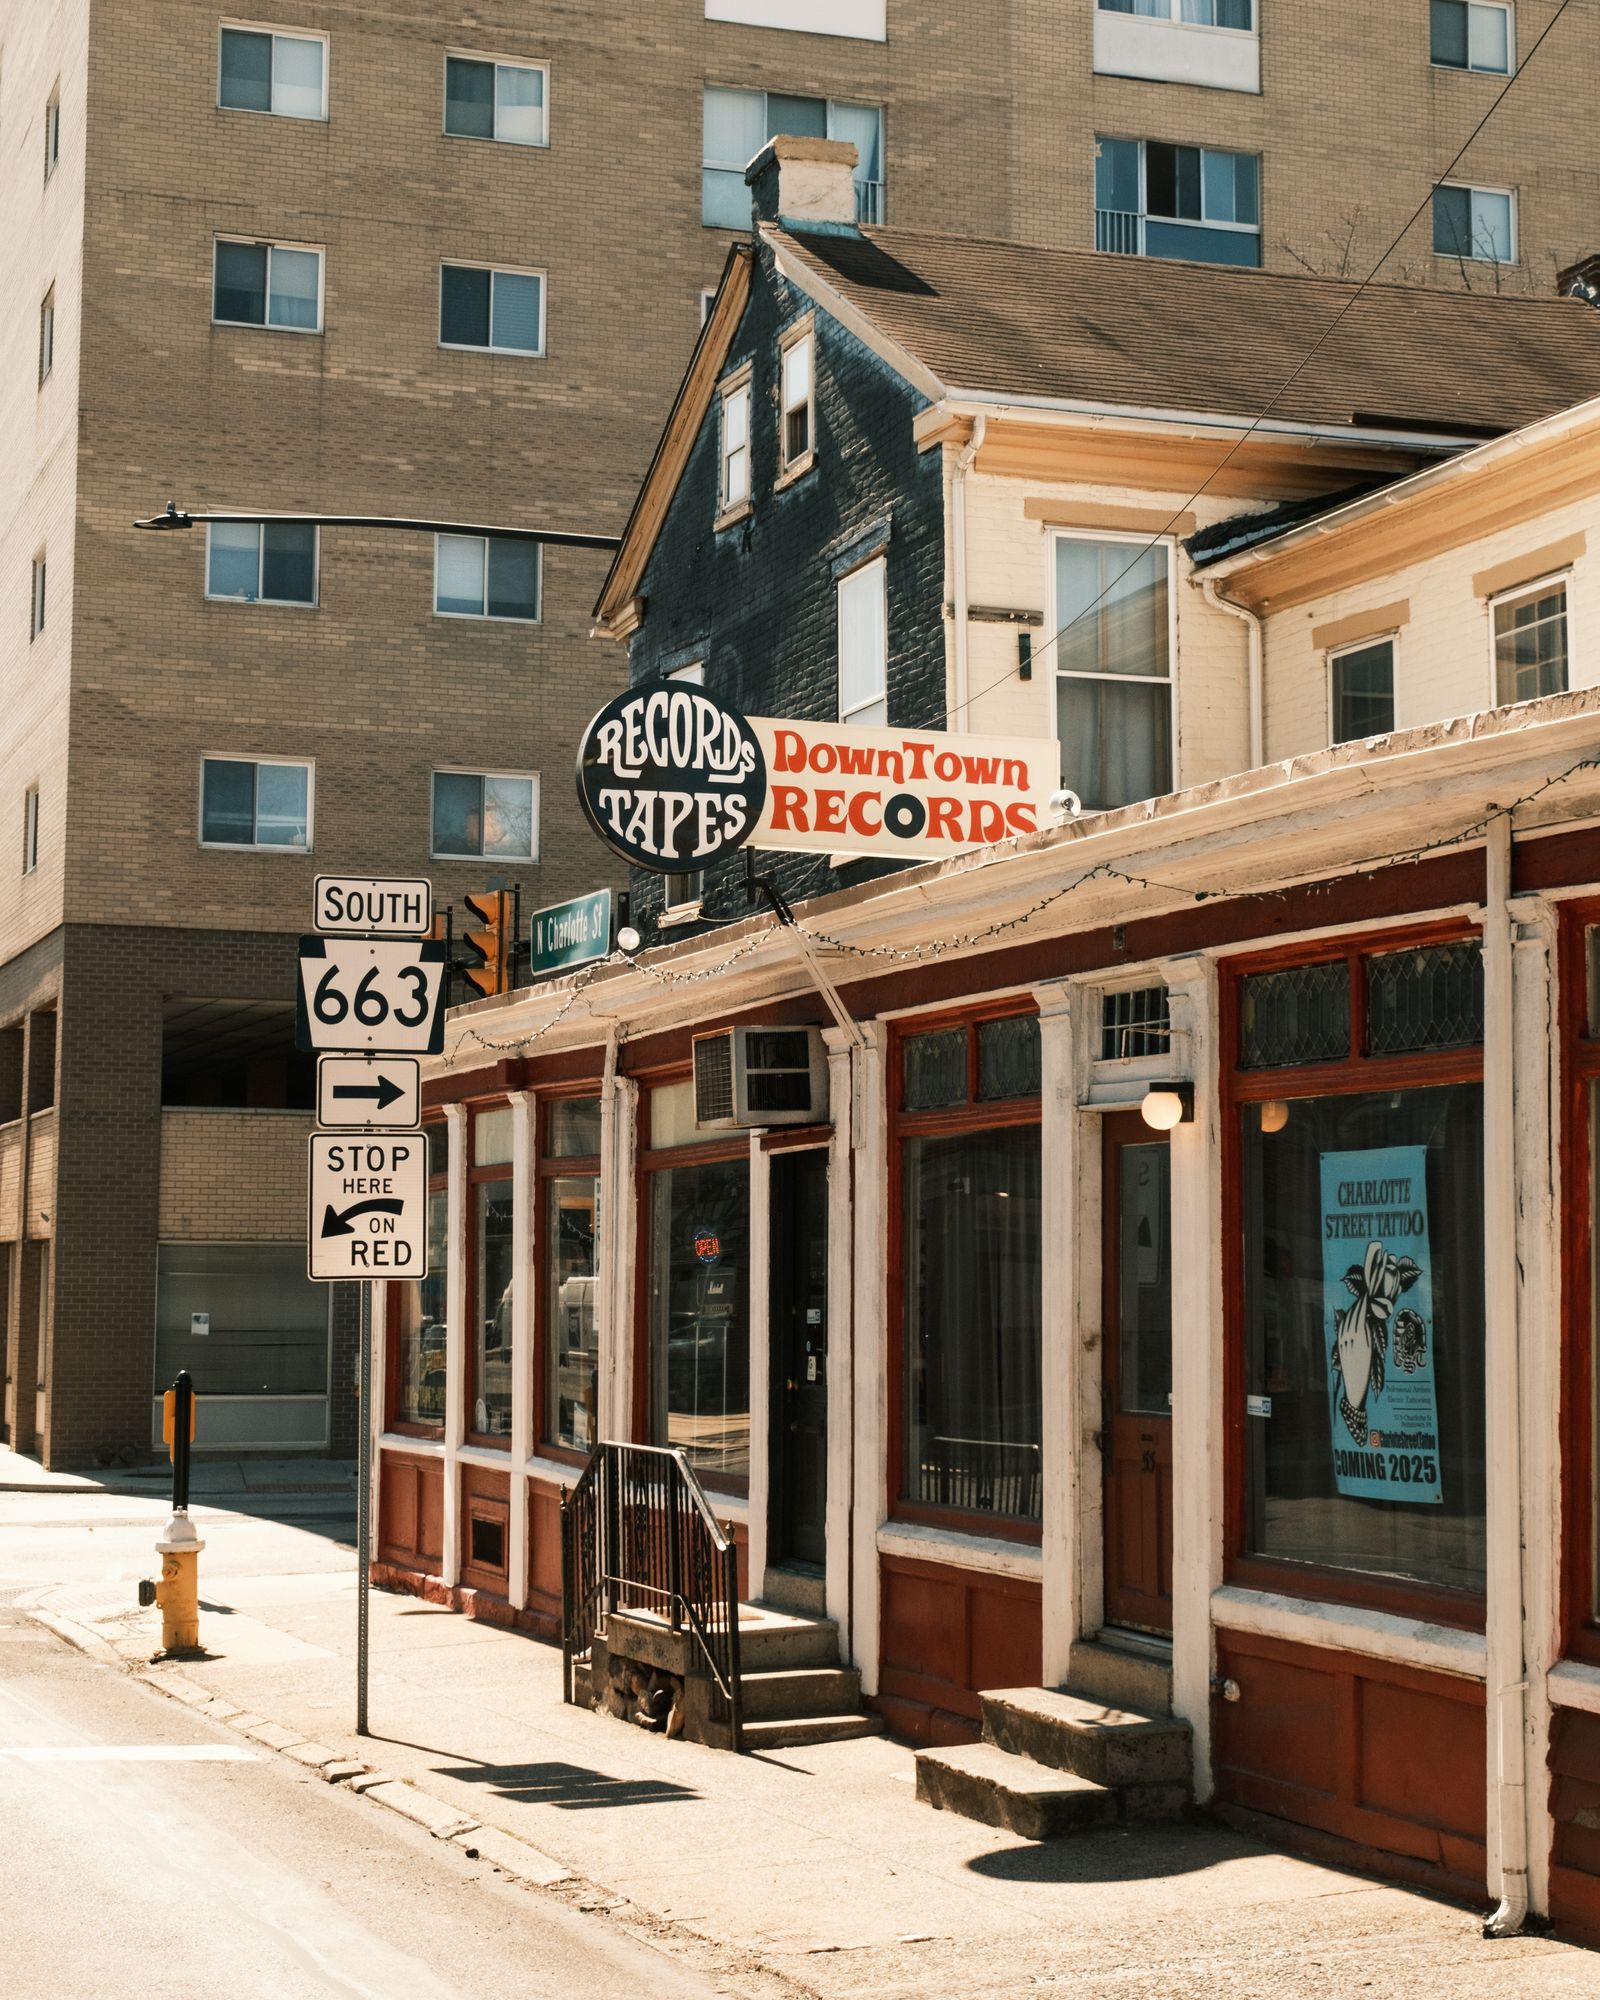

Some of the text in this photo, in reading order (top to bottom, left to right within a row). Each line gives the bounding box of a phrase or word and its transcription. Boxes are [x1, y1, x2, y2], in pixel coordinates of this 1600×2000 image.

[597, 691, 756, 784] RECORDS
[773, 730, 1031, 792] DownTown
[598, 788, 748, 859] TAPES
[770, 784, 1039, 844] RECORDS
[324, 886, 421, 924] SOUTH
[537, 903, 603, 955] N Charlotte St
[313, 964, 429, 1027] 663
[327, 1145, 411, 1172] STOP
[343, 1178, 393, 1194] HERE
[1338, 1178, 1411, 1207] CHARLOTTE
[369, 1217, 395, 1234] ON
[1325, 1209, 1424, 1239] STREET TATTOO
[351, 1240, 412, 1267] RED
[695, 1238, 719, 1256] OPEN
[1335, 1448, 1437, 1484] COMING 2025
